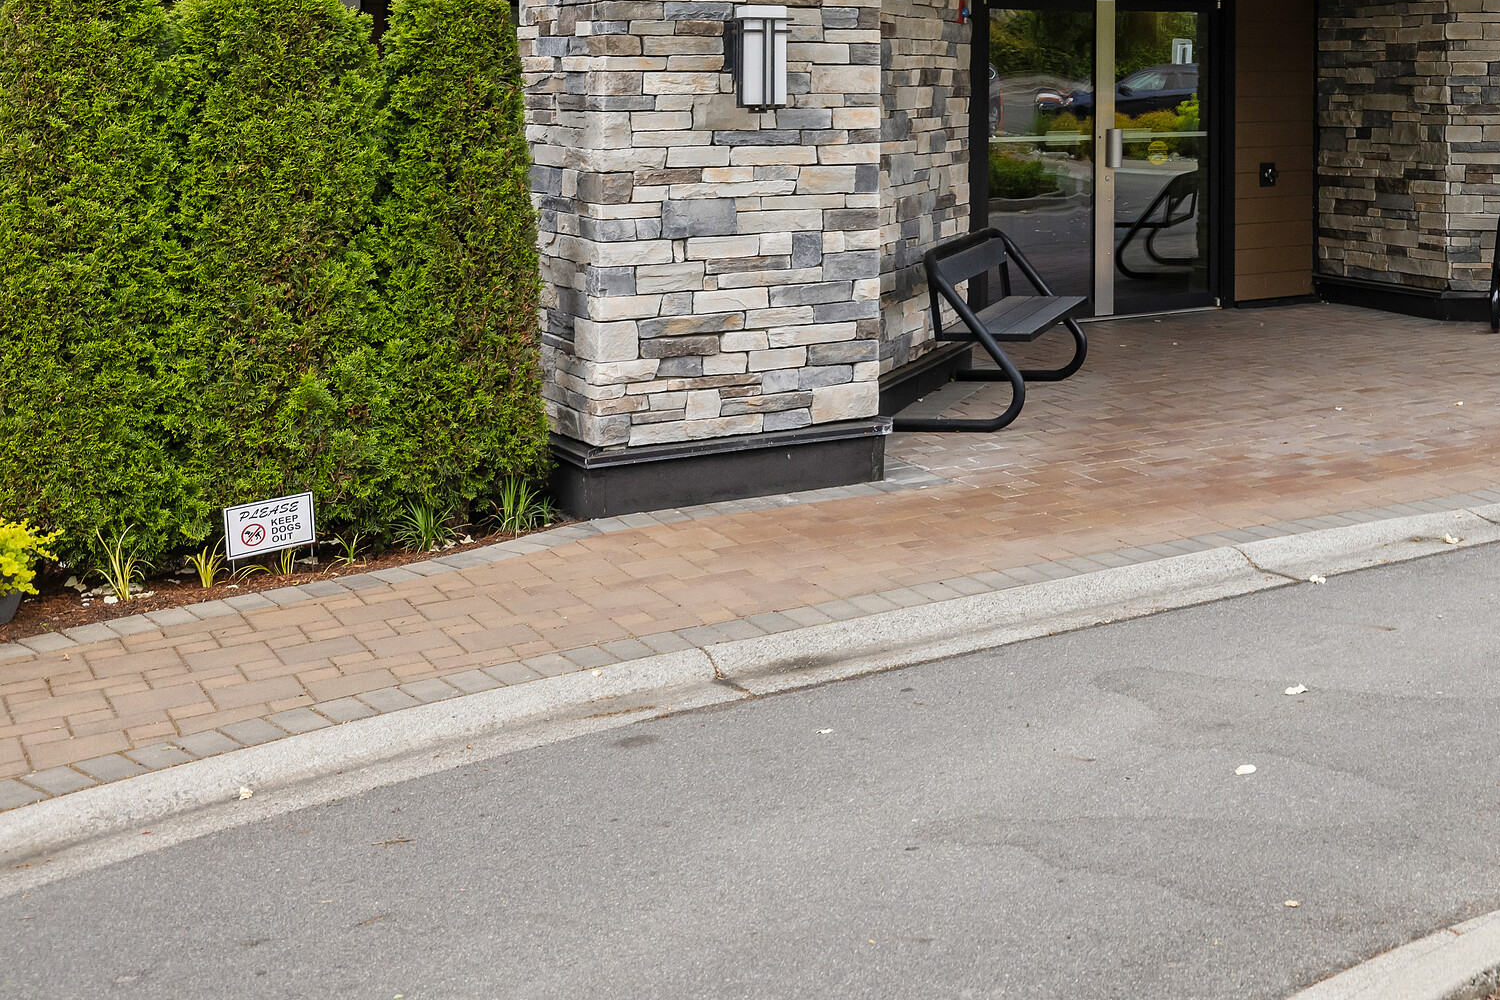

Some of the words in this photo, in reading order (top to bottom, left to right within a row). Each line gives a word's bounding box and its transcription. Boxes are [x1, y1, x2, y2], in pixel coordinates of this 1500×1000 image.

[239, 501, 299, 522] PLEASE
[270, 514, 299, 527] KEEP
[271, 522, 301, 535] DOGS
[271, 532, 294, 543] OUT
